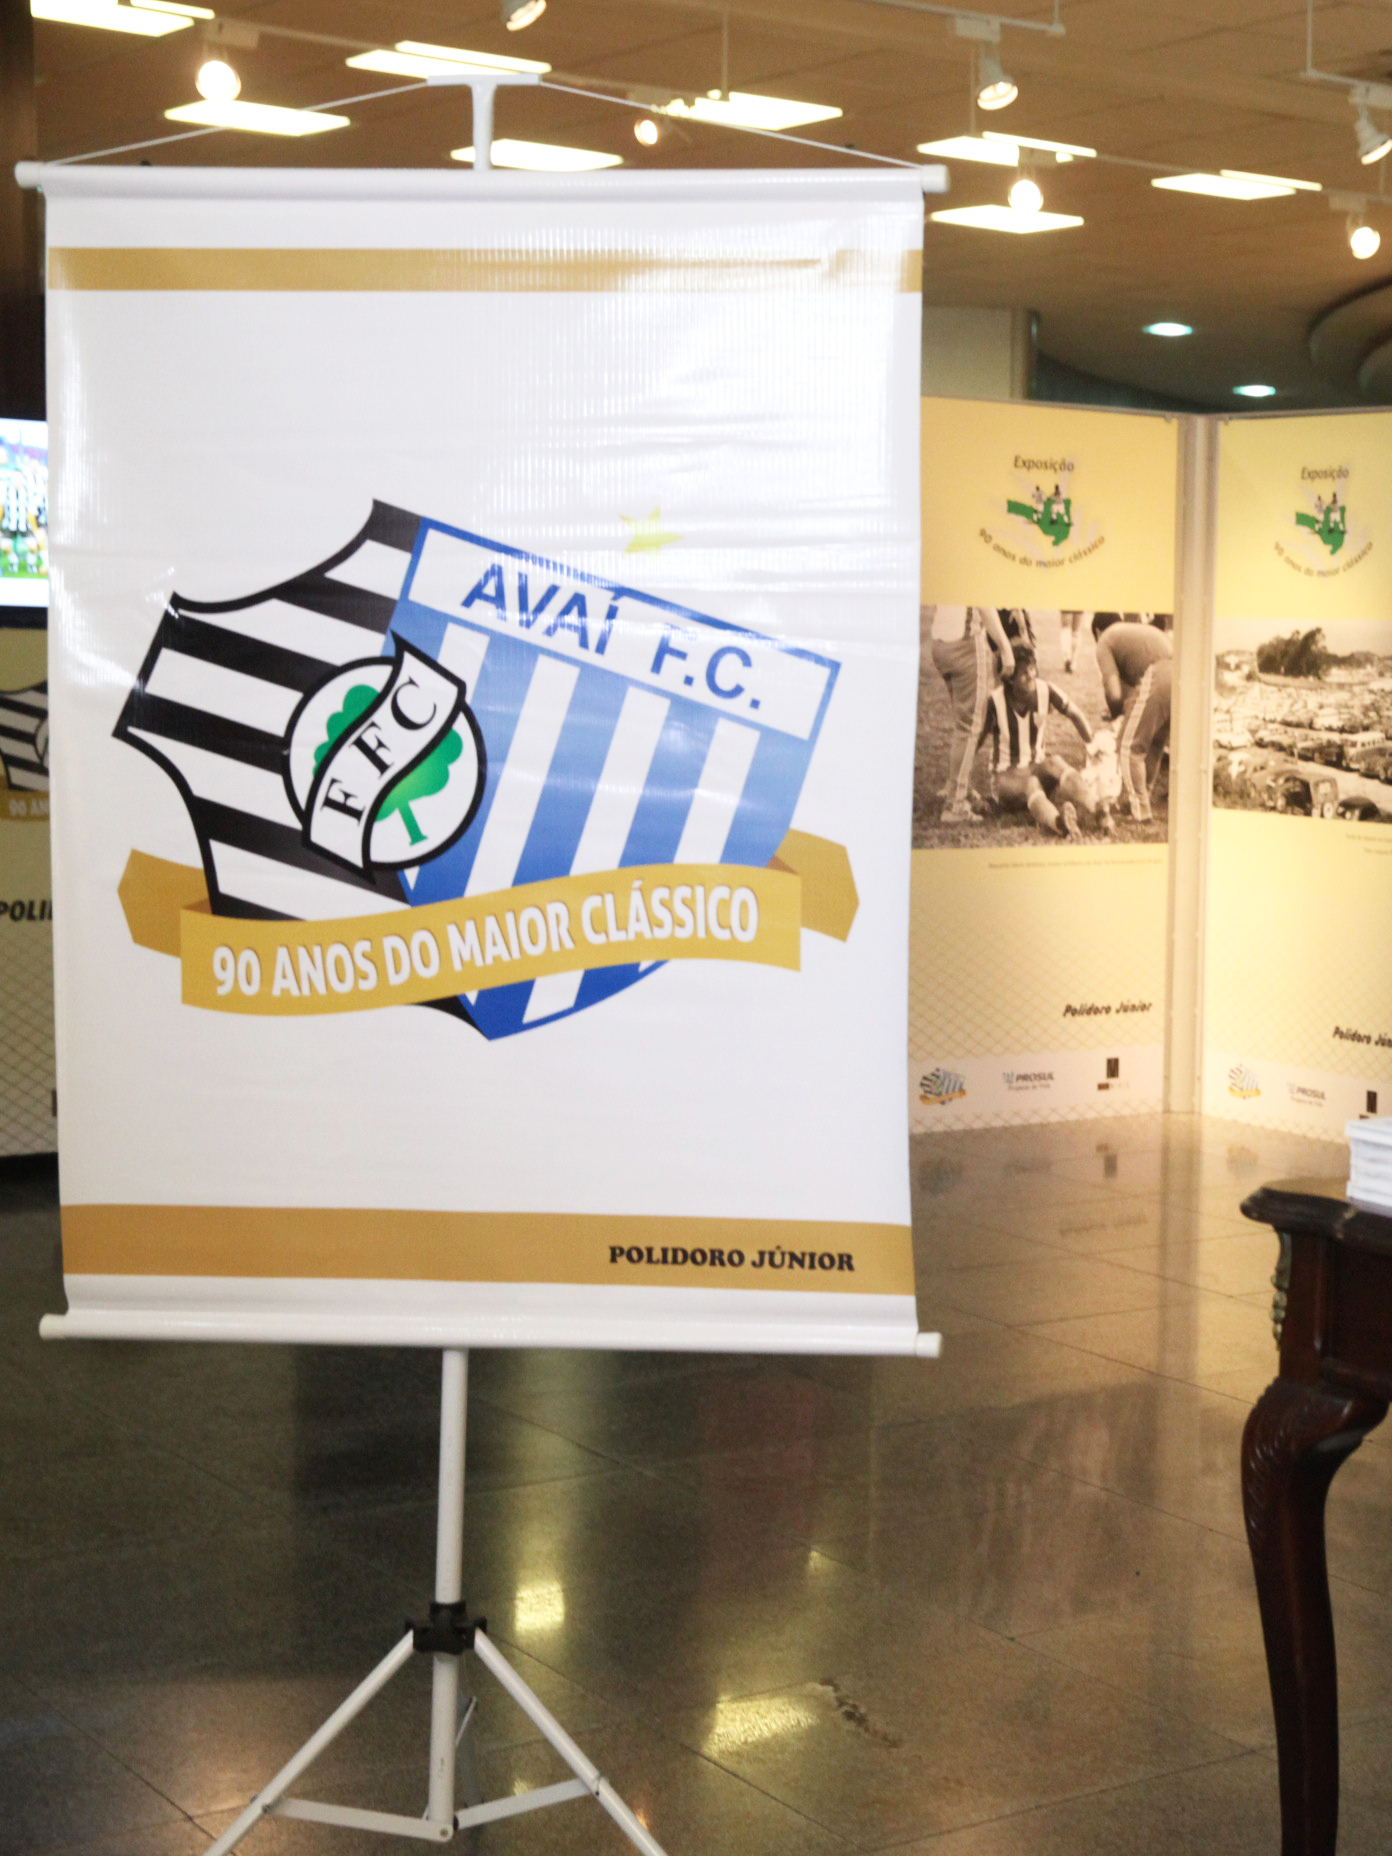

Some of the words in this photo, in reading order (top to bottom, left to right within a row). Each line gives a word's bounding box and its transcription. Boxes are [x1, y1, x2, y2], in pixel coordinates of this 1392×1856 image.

[1013, 455, 1075, 474] Exposição
[1301, 466, 1350, 482] Exposição
[979, 528, 993, 545] 90
[992, 543, 1016, 562] anos
[1019, 557, 1033, 567] do
[1035, 558, 1065, 569] maior
[1068, 535, 1106, 564] clássico
[460, 562, 628, 656] AVAÍ
[650, 622, 761, 710] F.C.
[0, 900, 52, 922] POLI
[212, 945, 261, 996] 90
[271, 940, 378, 997] ANOS
[382, 929, 441, 986] DO
[446, 901, 575, 971] MAIOR
[581, 879, 759, 944] CLÁSSICO
[1062, 1003, 1112, 1018] Polidoro
[1114, 1000, 1153, 1015] Júnior
[1332, 1026, 1372, 1045] Polidoro
[1015, 1072, 1055, 1082] PROSUL
[608, 1245, 746, 1268] POLIDORO
[751, 1245, 855, 1272] JÚNIOR
